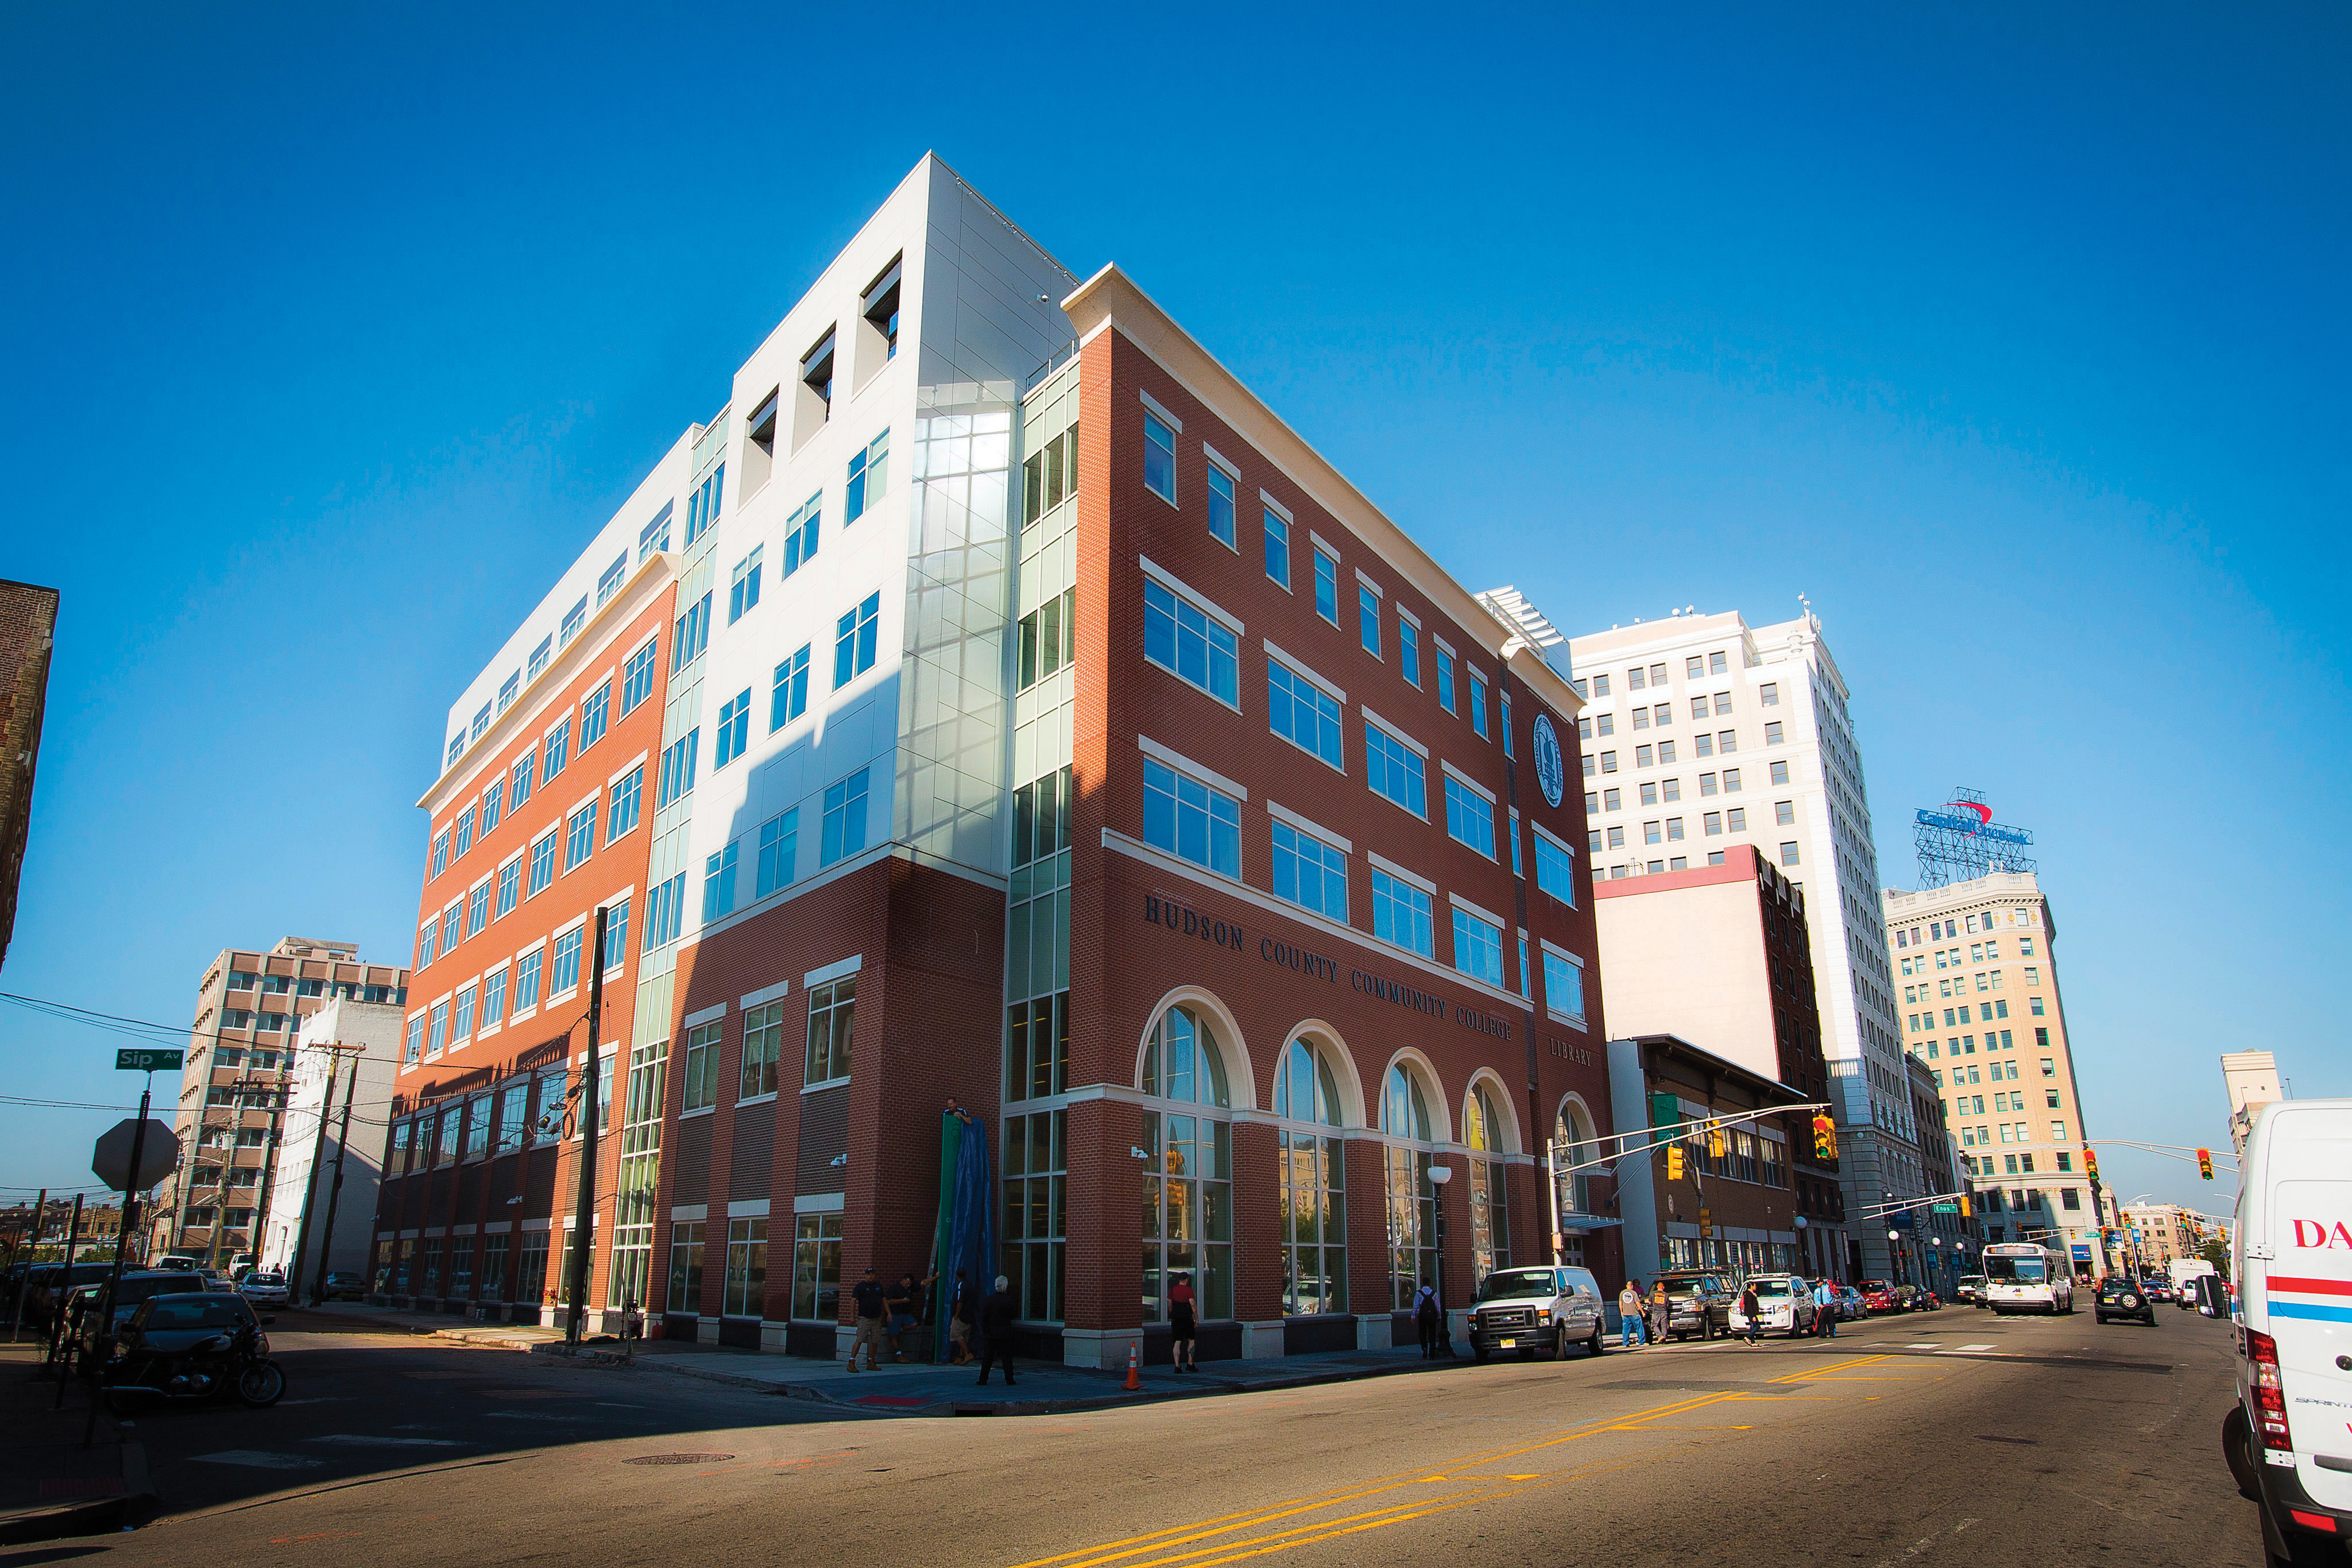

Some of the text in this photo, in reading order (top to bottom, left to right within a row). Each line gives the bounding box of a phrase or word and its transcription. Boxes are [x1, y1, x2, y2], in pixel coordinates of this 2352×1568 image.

[1145, 895, 1512, 1040] HUDSON COUNTY COMMUNITY COLLEGE
[120, 1051, 153, 1068] Sip
[1550, 1037, 1591, 1067] LIBRARY
[2295, 1397, 2352, 1408] SPRINT
